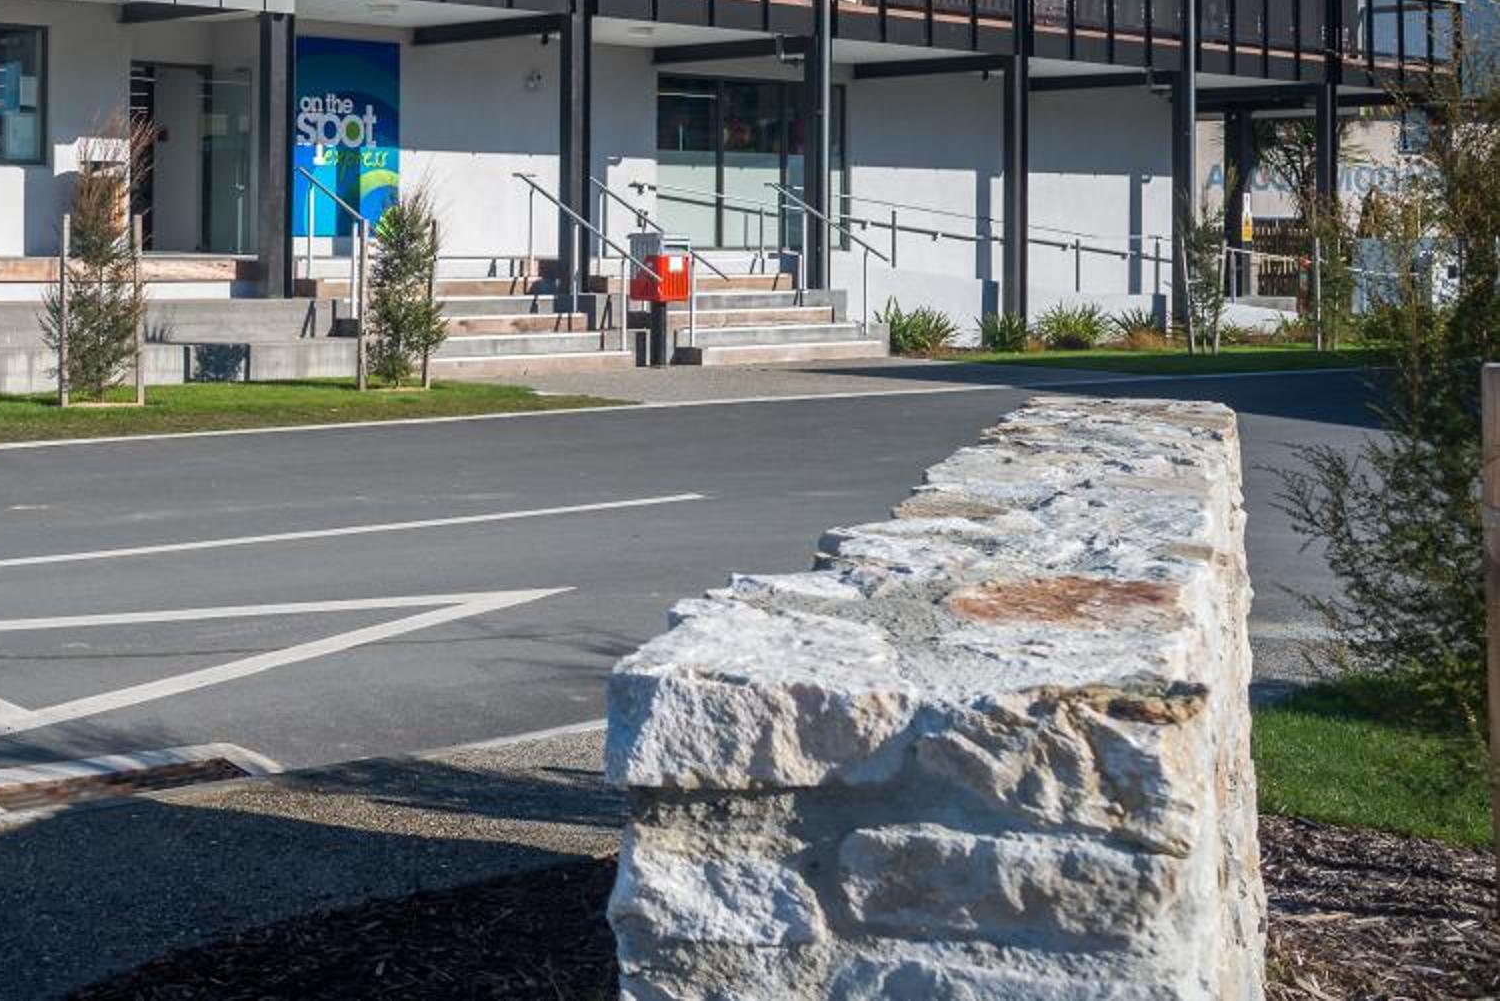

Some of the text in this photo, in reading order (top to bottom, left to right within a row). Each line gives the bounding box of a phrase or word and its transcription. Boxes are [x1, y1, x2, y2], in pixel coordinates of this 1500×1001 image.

[300, 93, 353, 114] on the
[297, 104, 376, 165] spot
